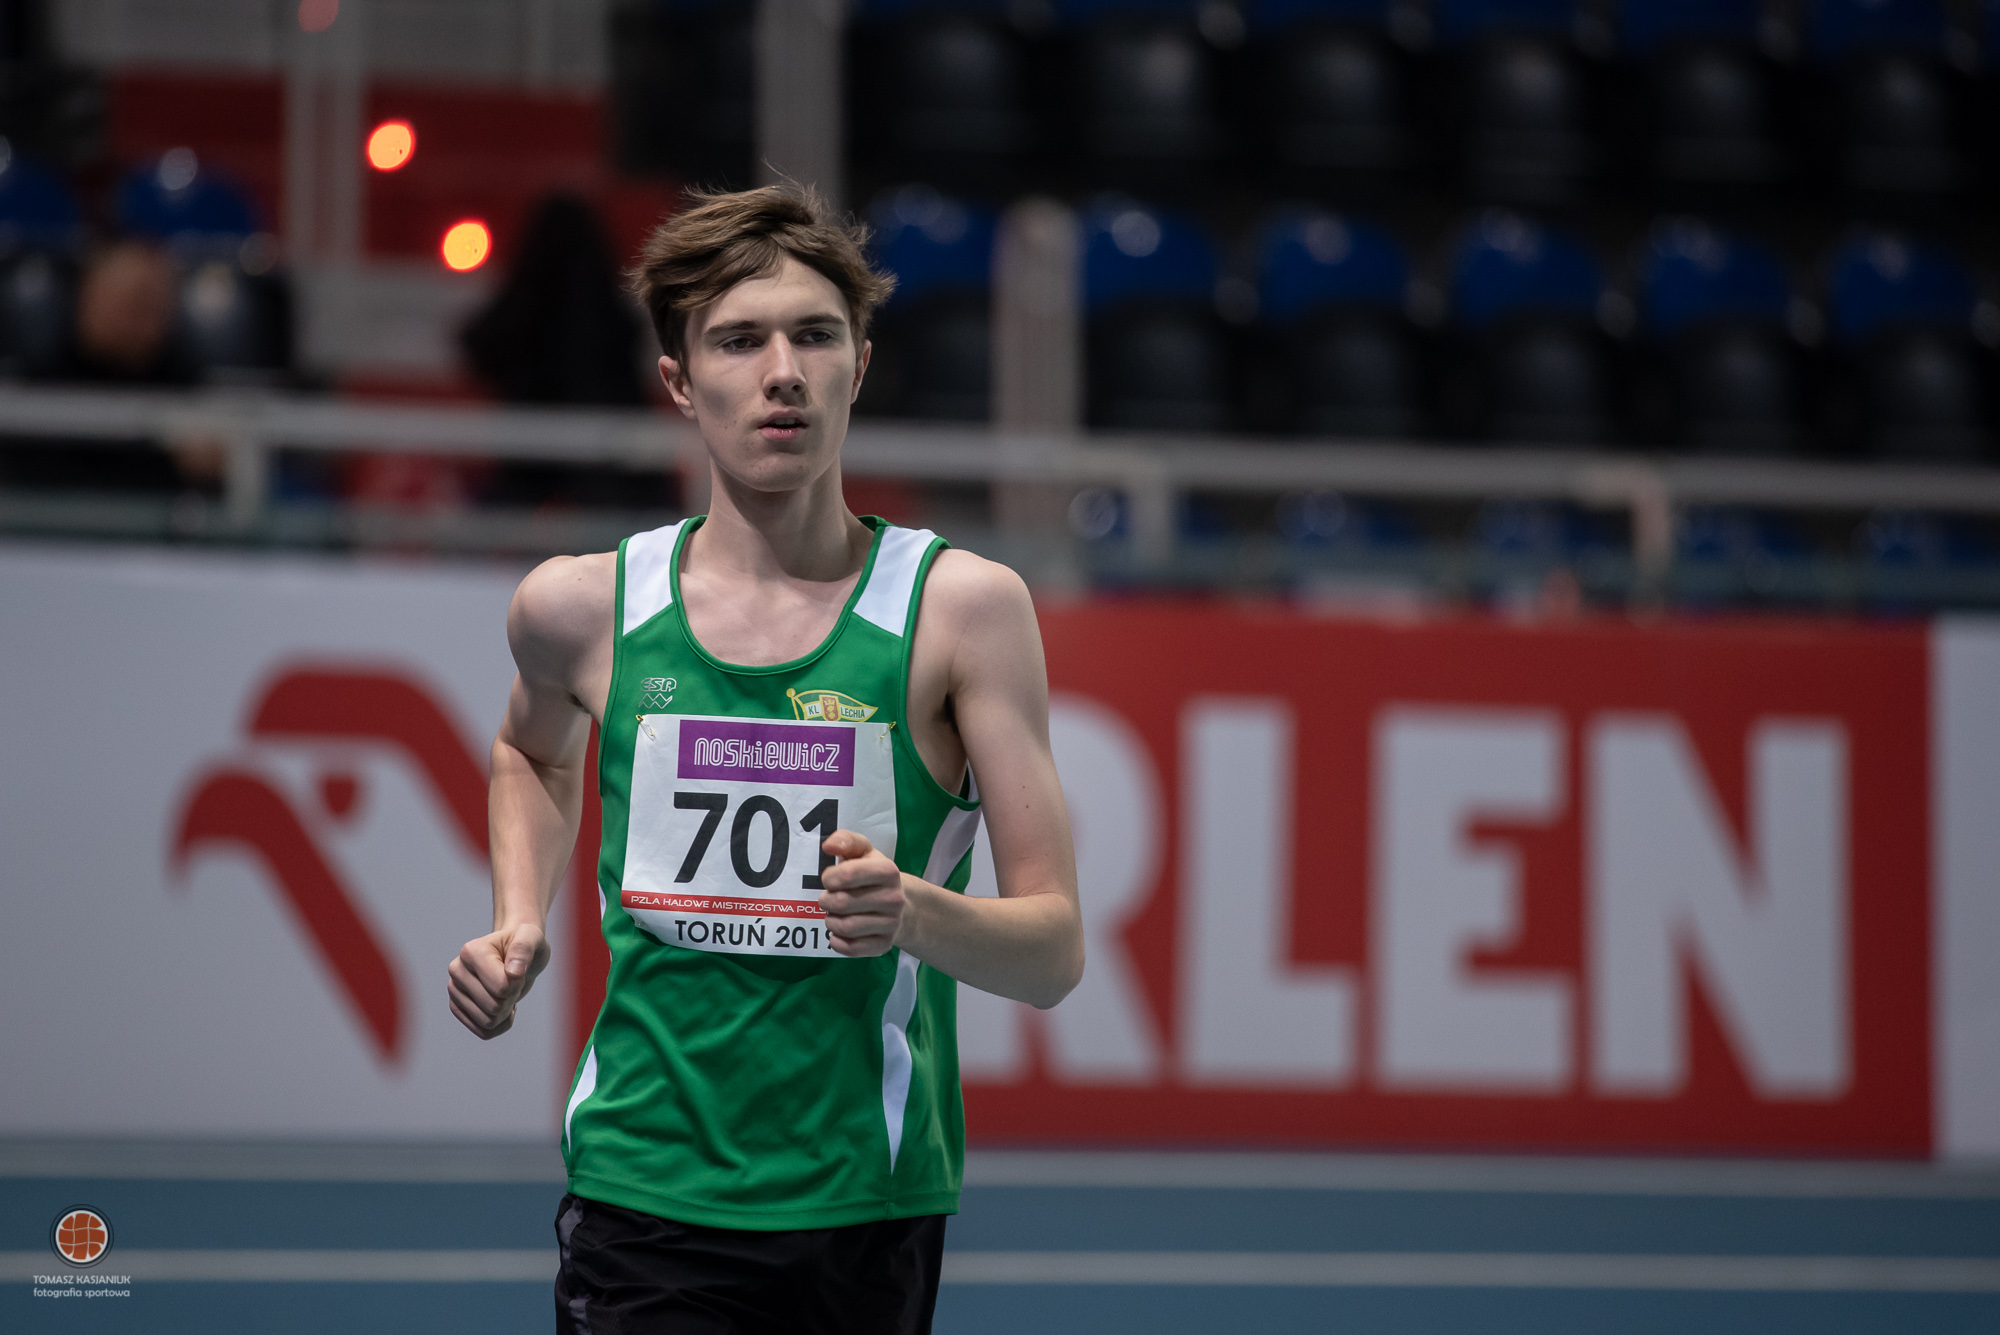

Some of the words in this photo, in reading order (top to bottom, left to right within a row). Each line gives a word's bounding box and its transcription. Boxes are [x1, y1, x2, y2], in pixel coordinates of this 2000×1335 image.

[808, 706, 820, 715] KL
[840, 708, 866, 719] LECHIA
[673, 791, 839, 889] 701
[630, 895, 661, 905] PZLA
[662, 898, 710, 909] HALOWE
[711, 901, 795, 913] MISTRZOSTWA
[957, 692, 1852, 1100] RLEN
[674, 917, 766, 947] TORUŃ
